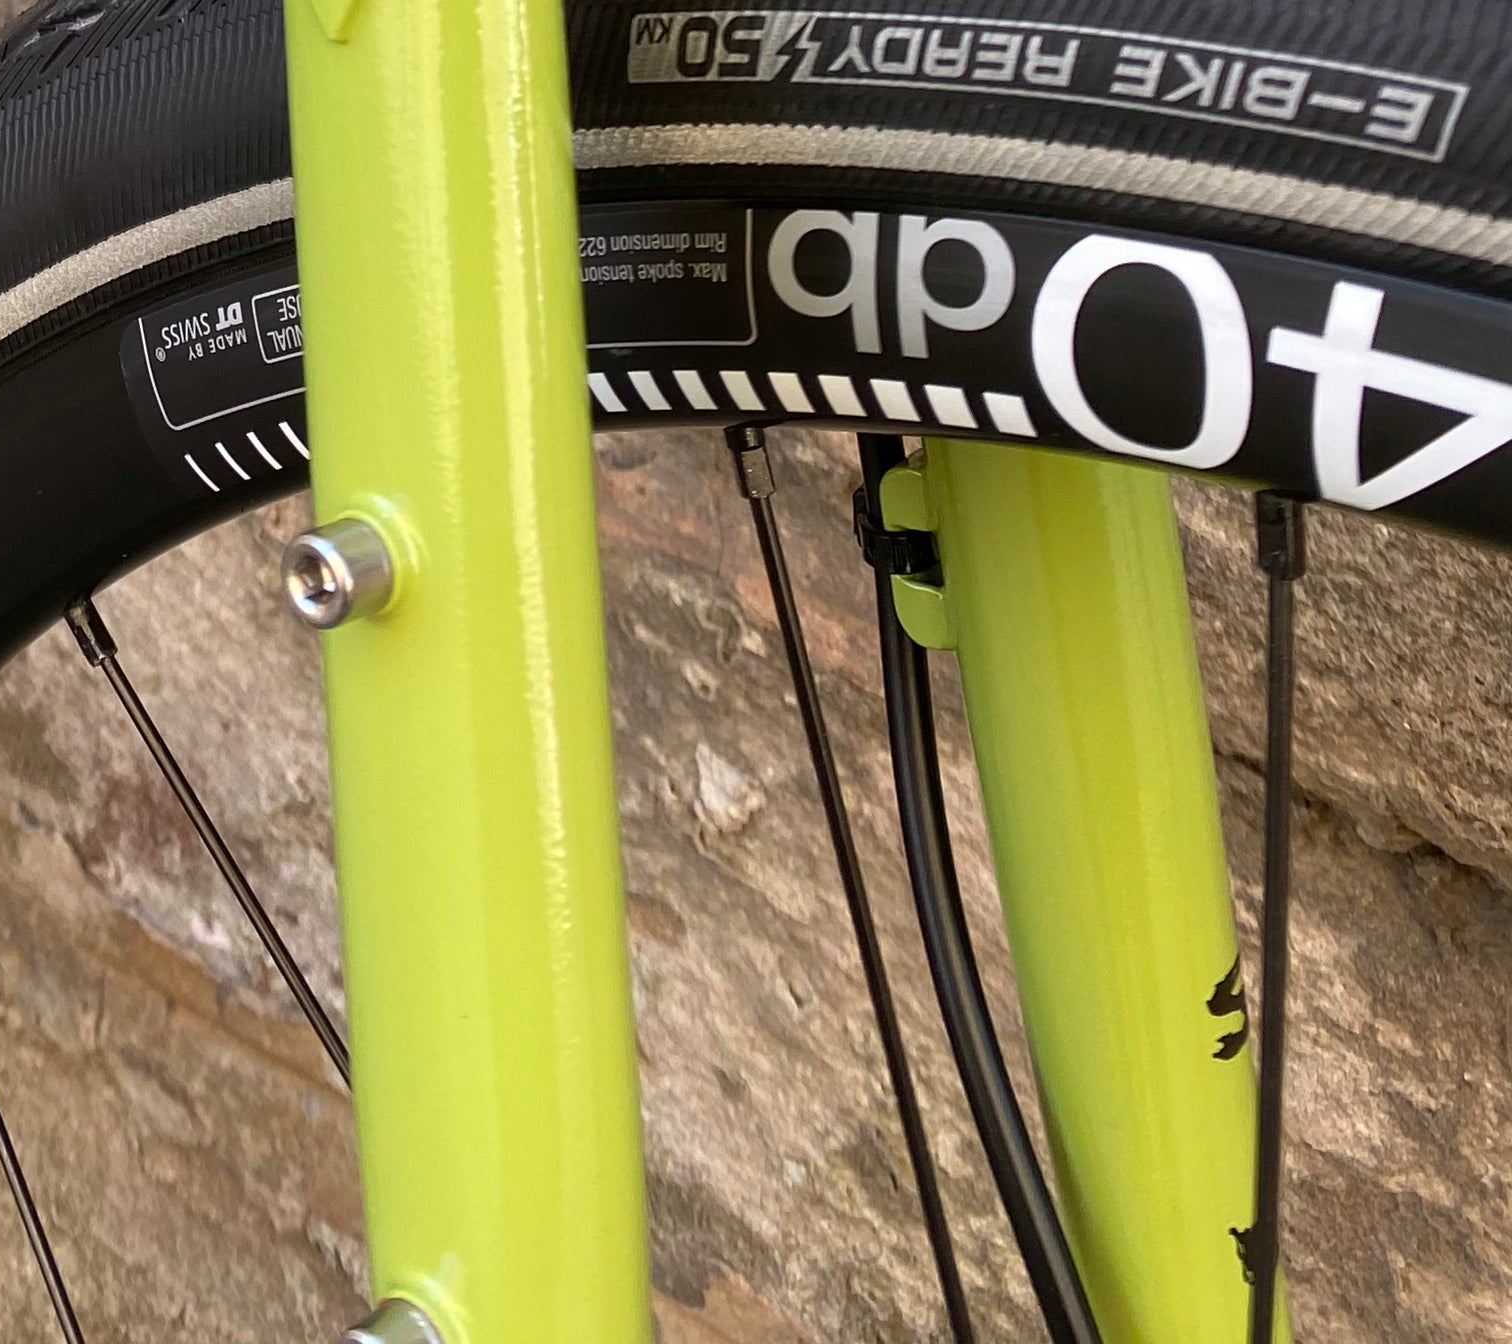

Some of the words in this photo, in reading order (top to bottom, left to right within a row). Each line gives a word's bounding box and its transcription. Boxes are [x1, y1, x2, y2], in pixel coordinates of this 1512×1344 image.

[829, 24, 1081, 89] READY
[1114, 43, 1435, 144] E-BIKE
[611, 233, 688, 254] dimension
[695, 233, 727, 253] Rim
[638, 259, 684, 283] spoke
[216, 302, 243, 330] DT
[188, 344, 204, 362] BY
[209, 327, 248, 354] MADE
